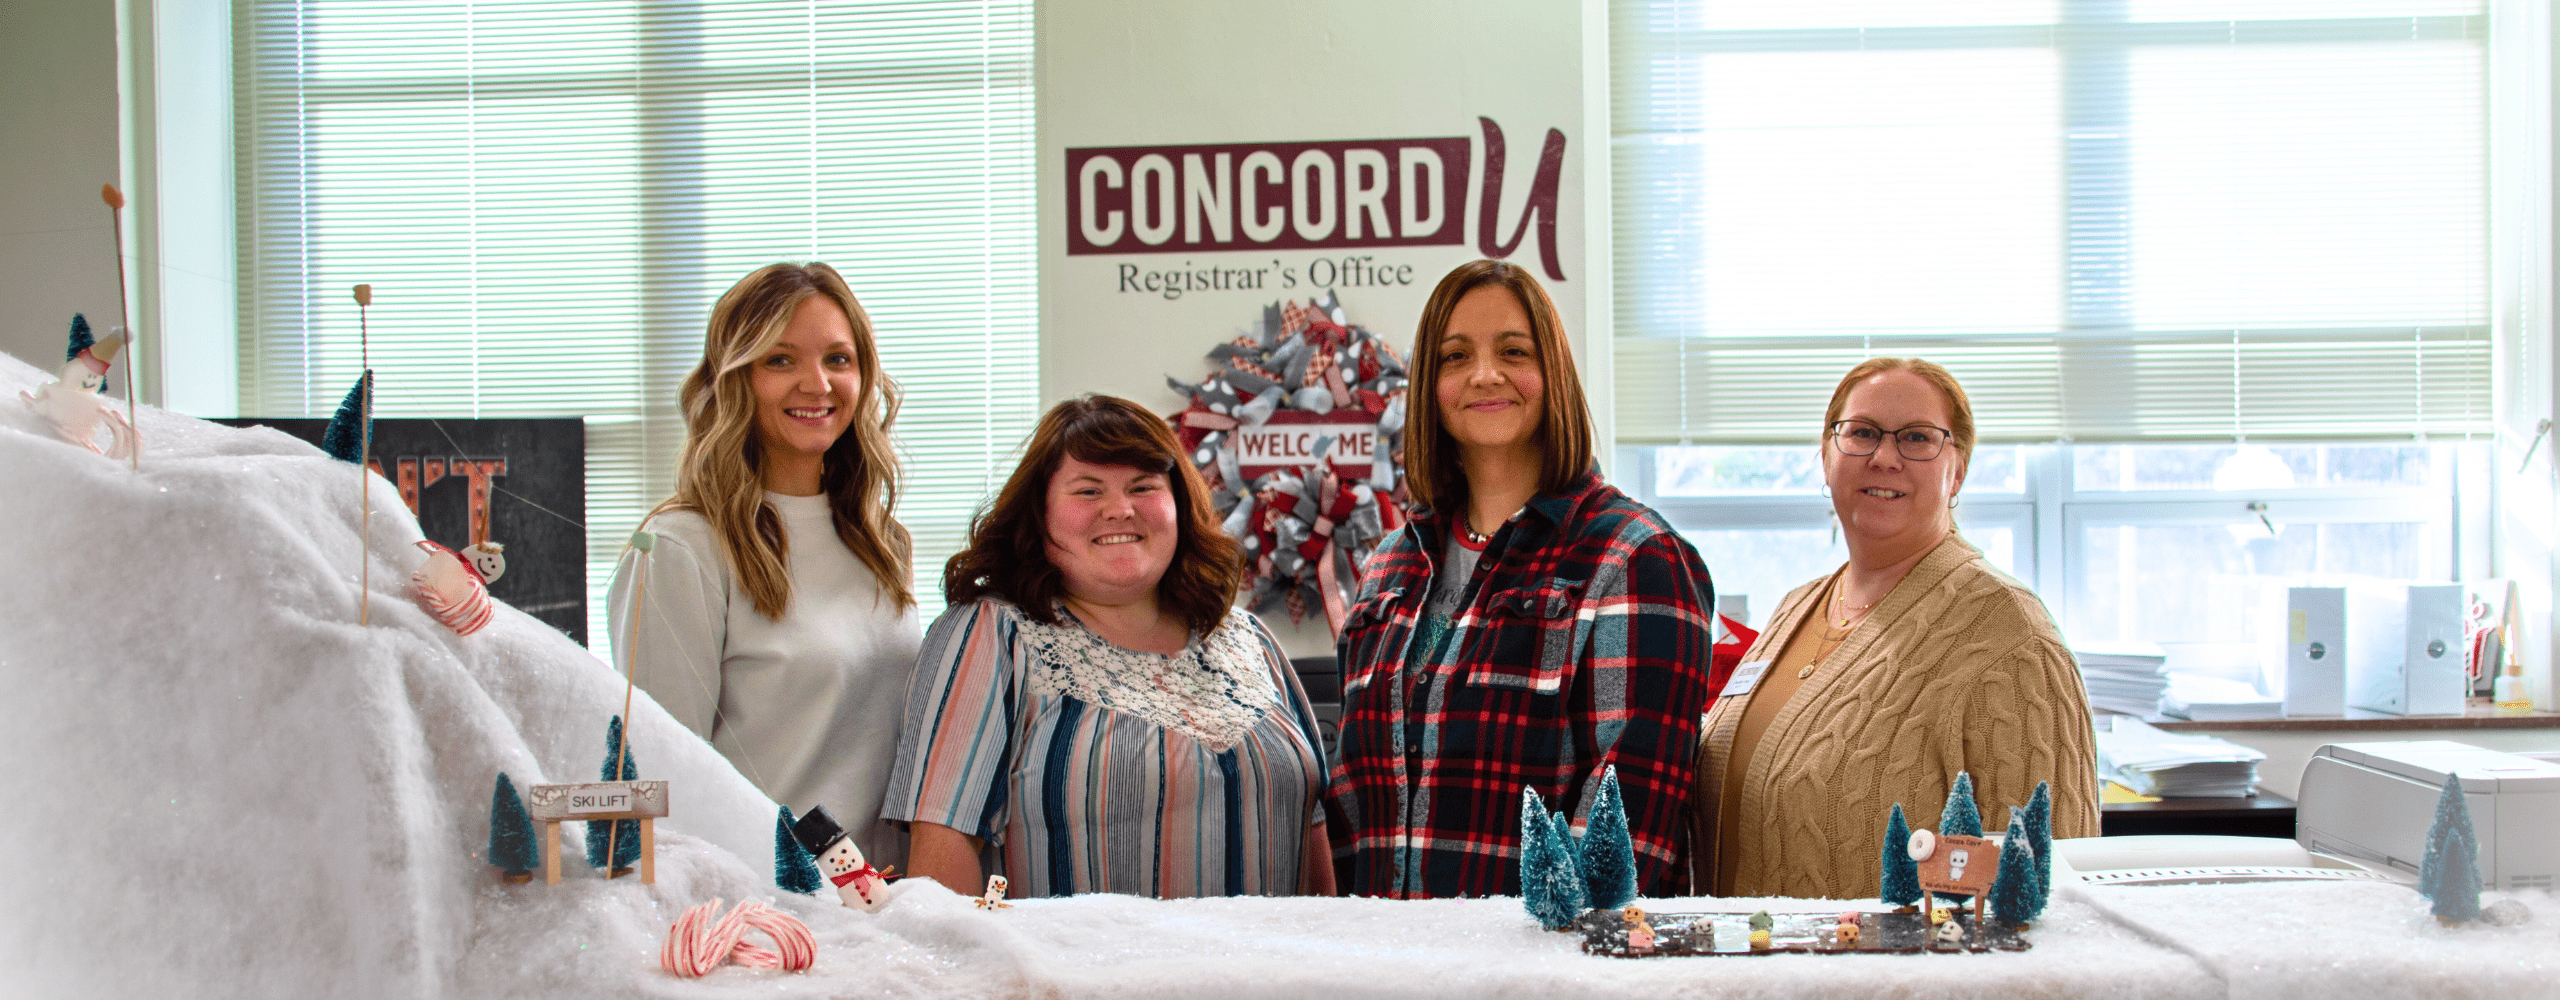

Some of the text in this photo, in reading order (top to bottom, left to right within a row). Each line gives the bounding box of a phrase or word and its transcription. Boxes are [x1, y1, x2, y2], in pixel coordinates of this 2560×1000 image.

[1079, 146, 1445, 247] CONCORD
[1117, 256, 1414, 300] Registrar’s Office
[1242, 432, 1373, 458] WELCME
[572, 794, 628, 808] SKI LIFT
